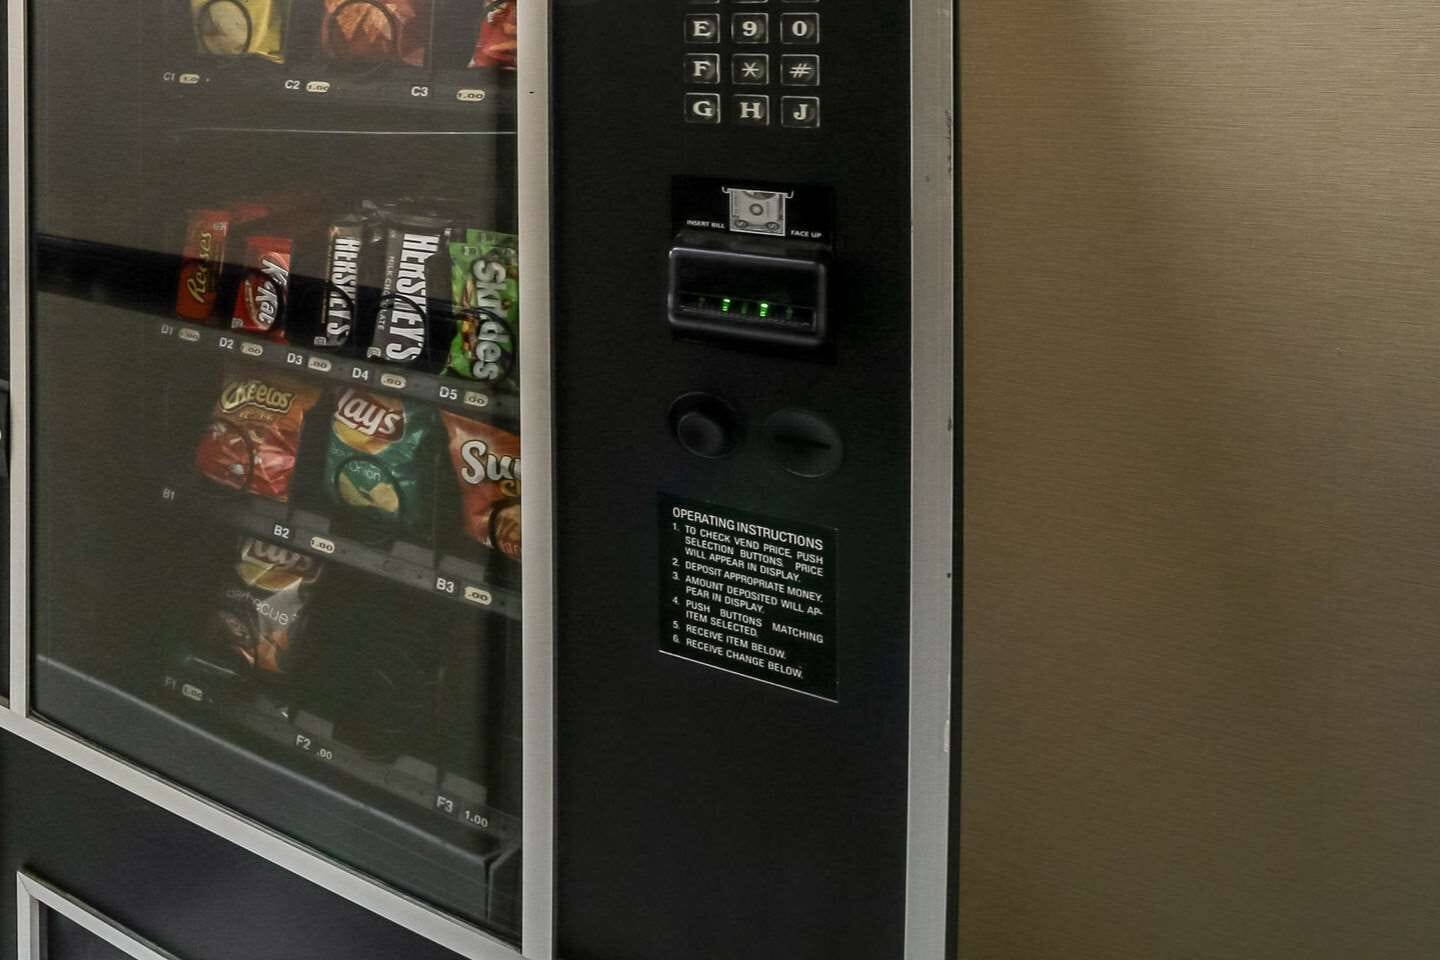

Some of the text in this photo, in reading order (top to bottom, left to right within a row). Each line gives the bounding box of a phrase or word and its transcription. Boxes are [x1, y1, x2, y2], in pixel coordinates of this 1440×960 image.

[693, 21, 711, 37] E
[742, 21, 757, 36] 9
[792, 20, 807, 36] 0
[163, 72, 175, 81] C1
[694, 61, 710, 76] F
[789, 63, 812, 78] #
[285, 80, 300, 90] C2
[411, 86, 428, 96] C3
[692, 100, 712, 117] G
[740, 102, 761, 119] H
[793, 104, 808, 120] J
[327, 238, 360, 336] HERSHEYS
[219, 337, 234, 349] D2
[287, 352, 303, 365] D3
[352, 367, 369, 381] D4
[439, 386, 458, 400] D5
[162, 488, 175, 500] B1
[274, 525, 289, 539] B2
[673, 506, 823, 551] OPERATING INSTRUCTIONS
[685, 524, 697, 535] TO
[700, 528, 731, 543] CHECK
[734, 536, 759, 550] VEND
[797, 551, 823, 565] PUSH
[685, 536, 734, 555] SELECTION
[795, 563, 823, 576] PRICE
[685, 547, 706, 560] WILL
[709, 552, 745, 569] APPEAR
[747, 561, 757, 572] IN
[436, 577, 454, 593] B3
[685, 561, 722, 576] DEPOSIT
[724, 570, 785, 593] APPROPRIATE
[685, 575, 724, 591] AMOUNT
[727, 585, 777, 606] DEPOSITED
[781, 599, 804, 613] WILL
[807, 606, 823, 616] AP-
[686, 586, 709, 599] PEAR
[712, 593, 722, 602] IN
[686, 610, 707, 623] ITEM
[686, 599, 710, 613] PUSH
[720, 608, 762, 627] BUTTONS
[772, 623, 823, 644] MATCHING
[686, 624, 723, 642] RECEIVE
[726, 636, 748, 649] ITEM
[686, 638, 723, 656] RECEIVE
[726, 649, 764, 668] CHANGE
[295, 734, 311, 750] F2
[437, 795, 488, 828] F3 1.00
